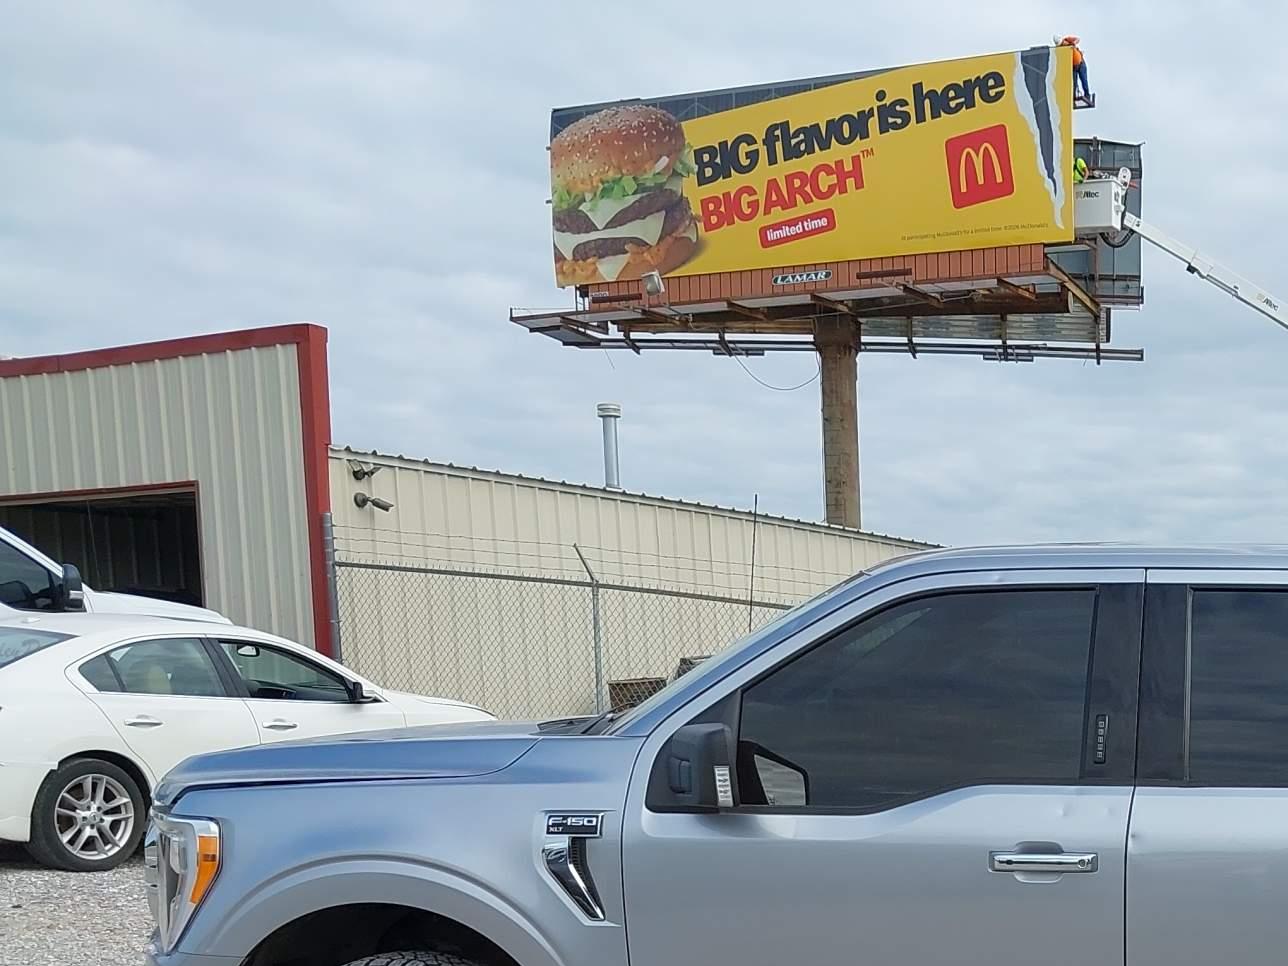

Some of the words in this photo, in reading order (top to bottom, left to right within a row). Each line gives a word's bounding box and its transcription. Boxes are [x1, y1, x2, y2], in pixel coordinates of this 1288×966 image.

[693, 133, 760, 187] BIG
[762, 105, 876, 167] flavor
[876, 89, 911, 135] is
[912, 71, 1006, 125] here
[699, 185, 760, 233] BIG
[767, 221, 803, 242] limited
[804, 215, 828, 232] time
[776, 271, 826, 284] LAMAR
[548, 816, 597, 826] F-150
